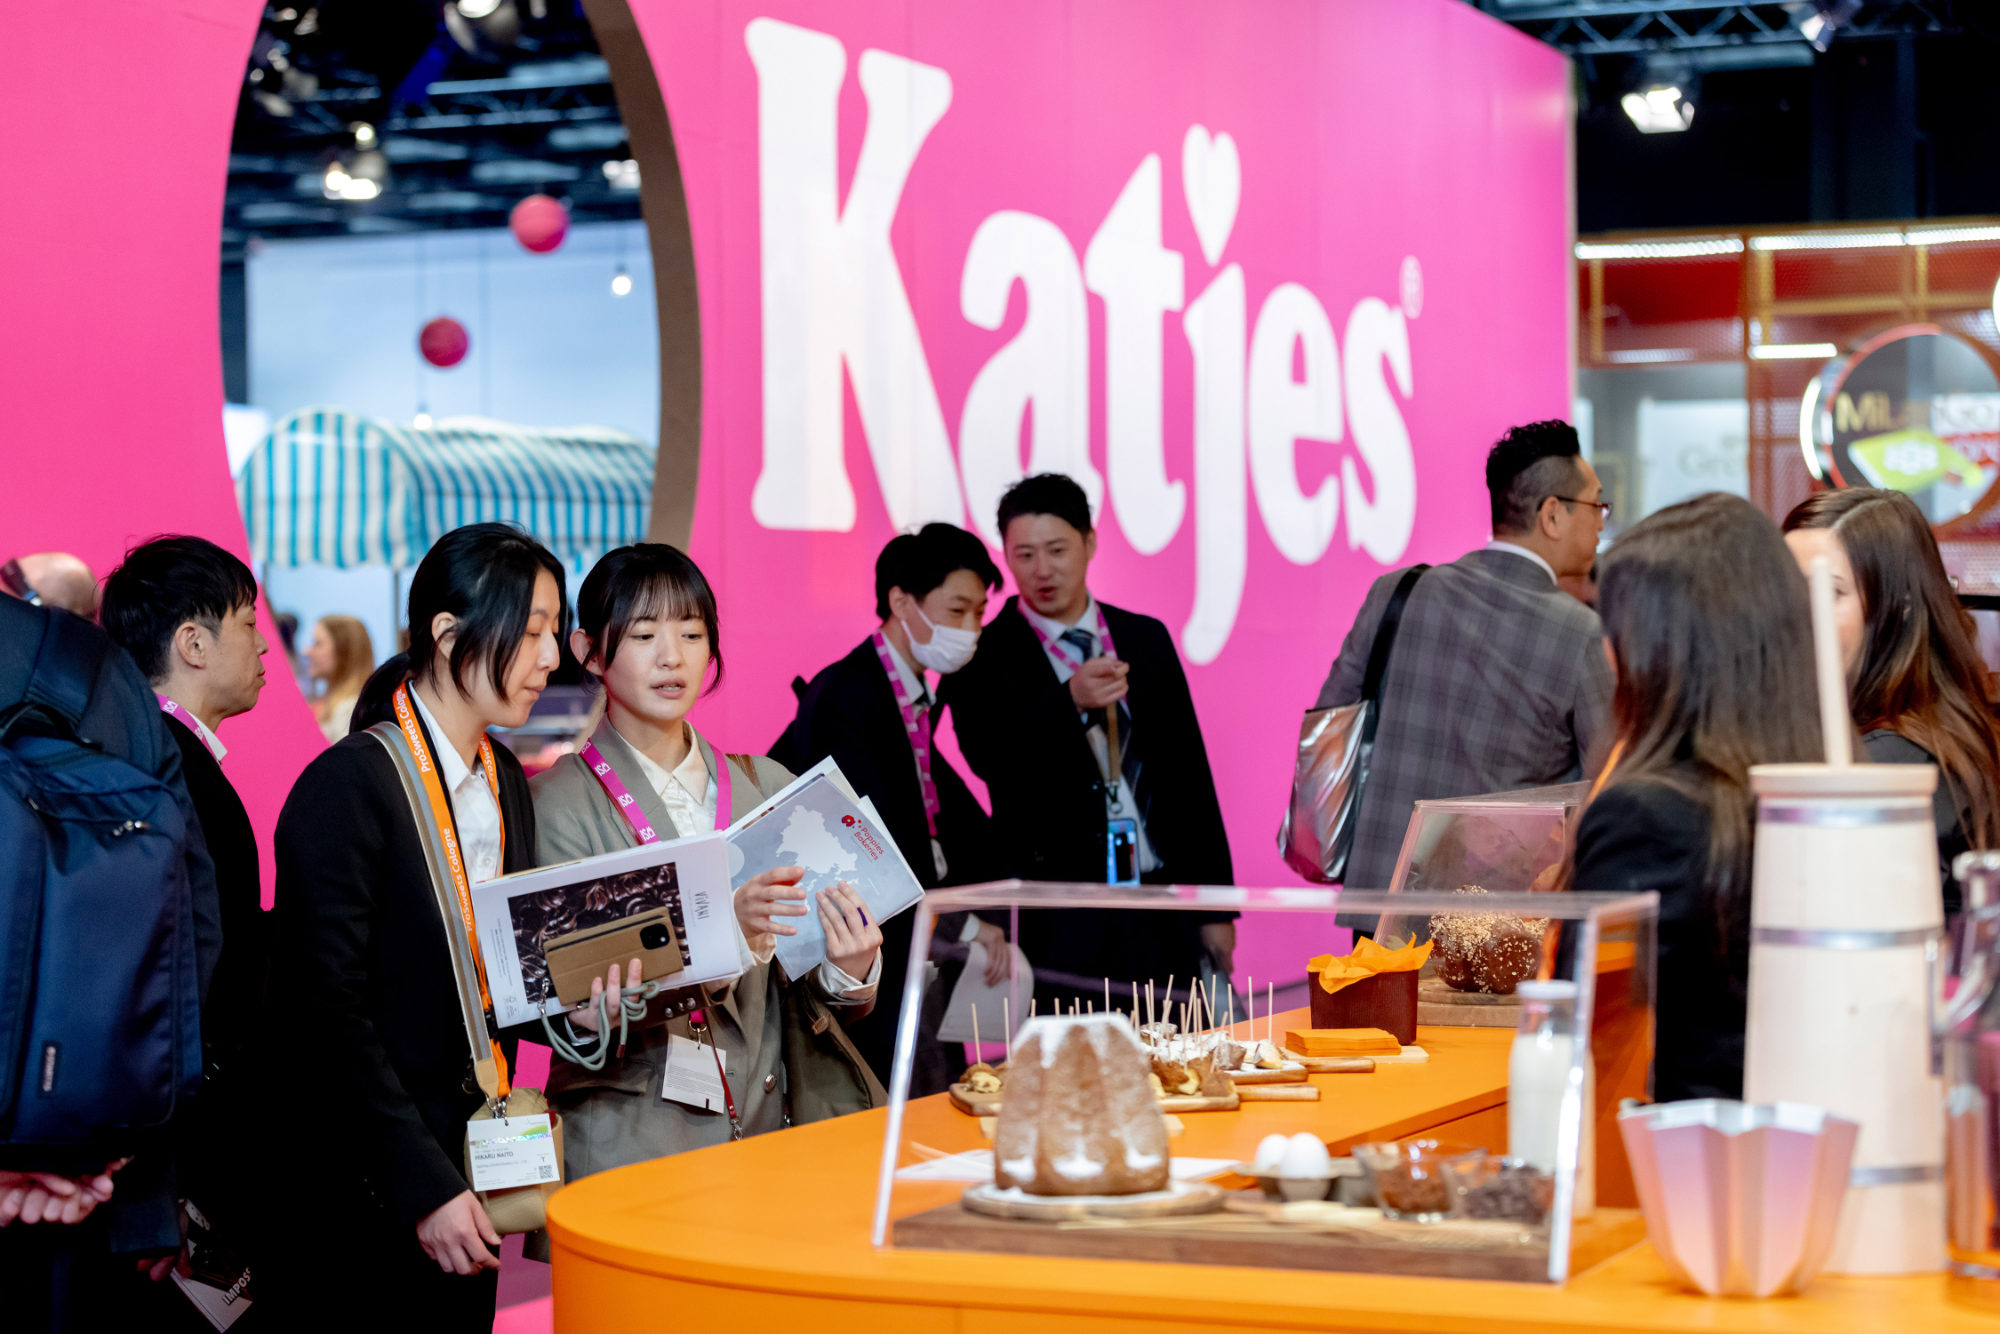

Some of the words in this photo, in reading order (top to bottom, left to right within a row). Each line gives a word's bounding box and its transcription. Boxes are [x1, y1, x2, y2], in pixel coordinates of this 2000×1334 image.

[744, 17, 1417, 664] Katjes
[405, 718, 431, 773] ProSweets
[443, 828, 460, 873] Cologne
[854, 831, 879, 860] Bakeries
[861, 827, 884, 854] Poppies
